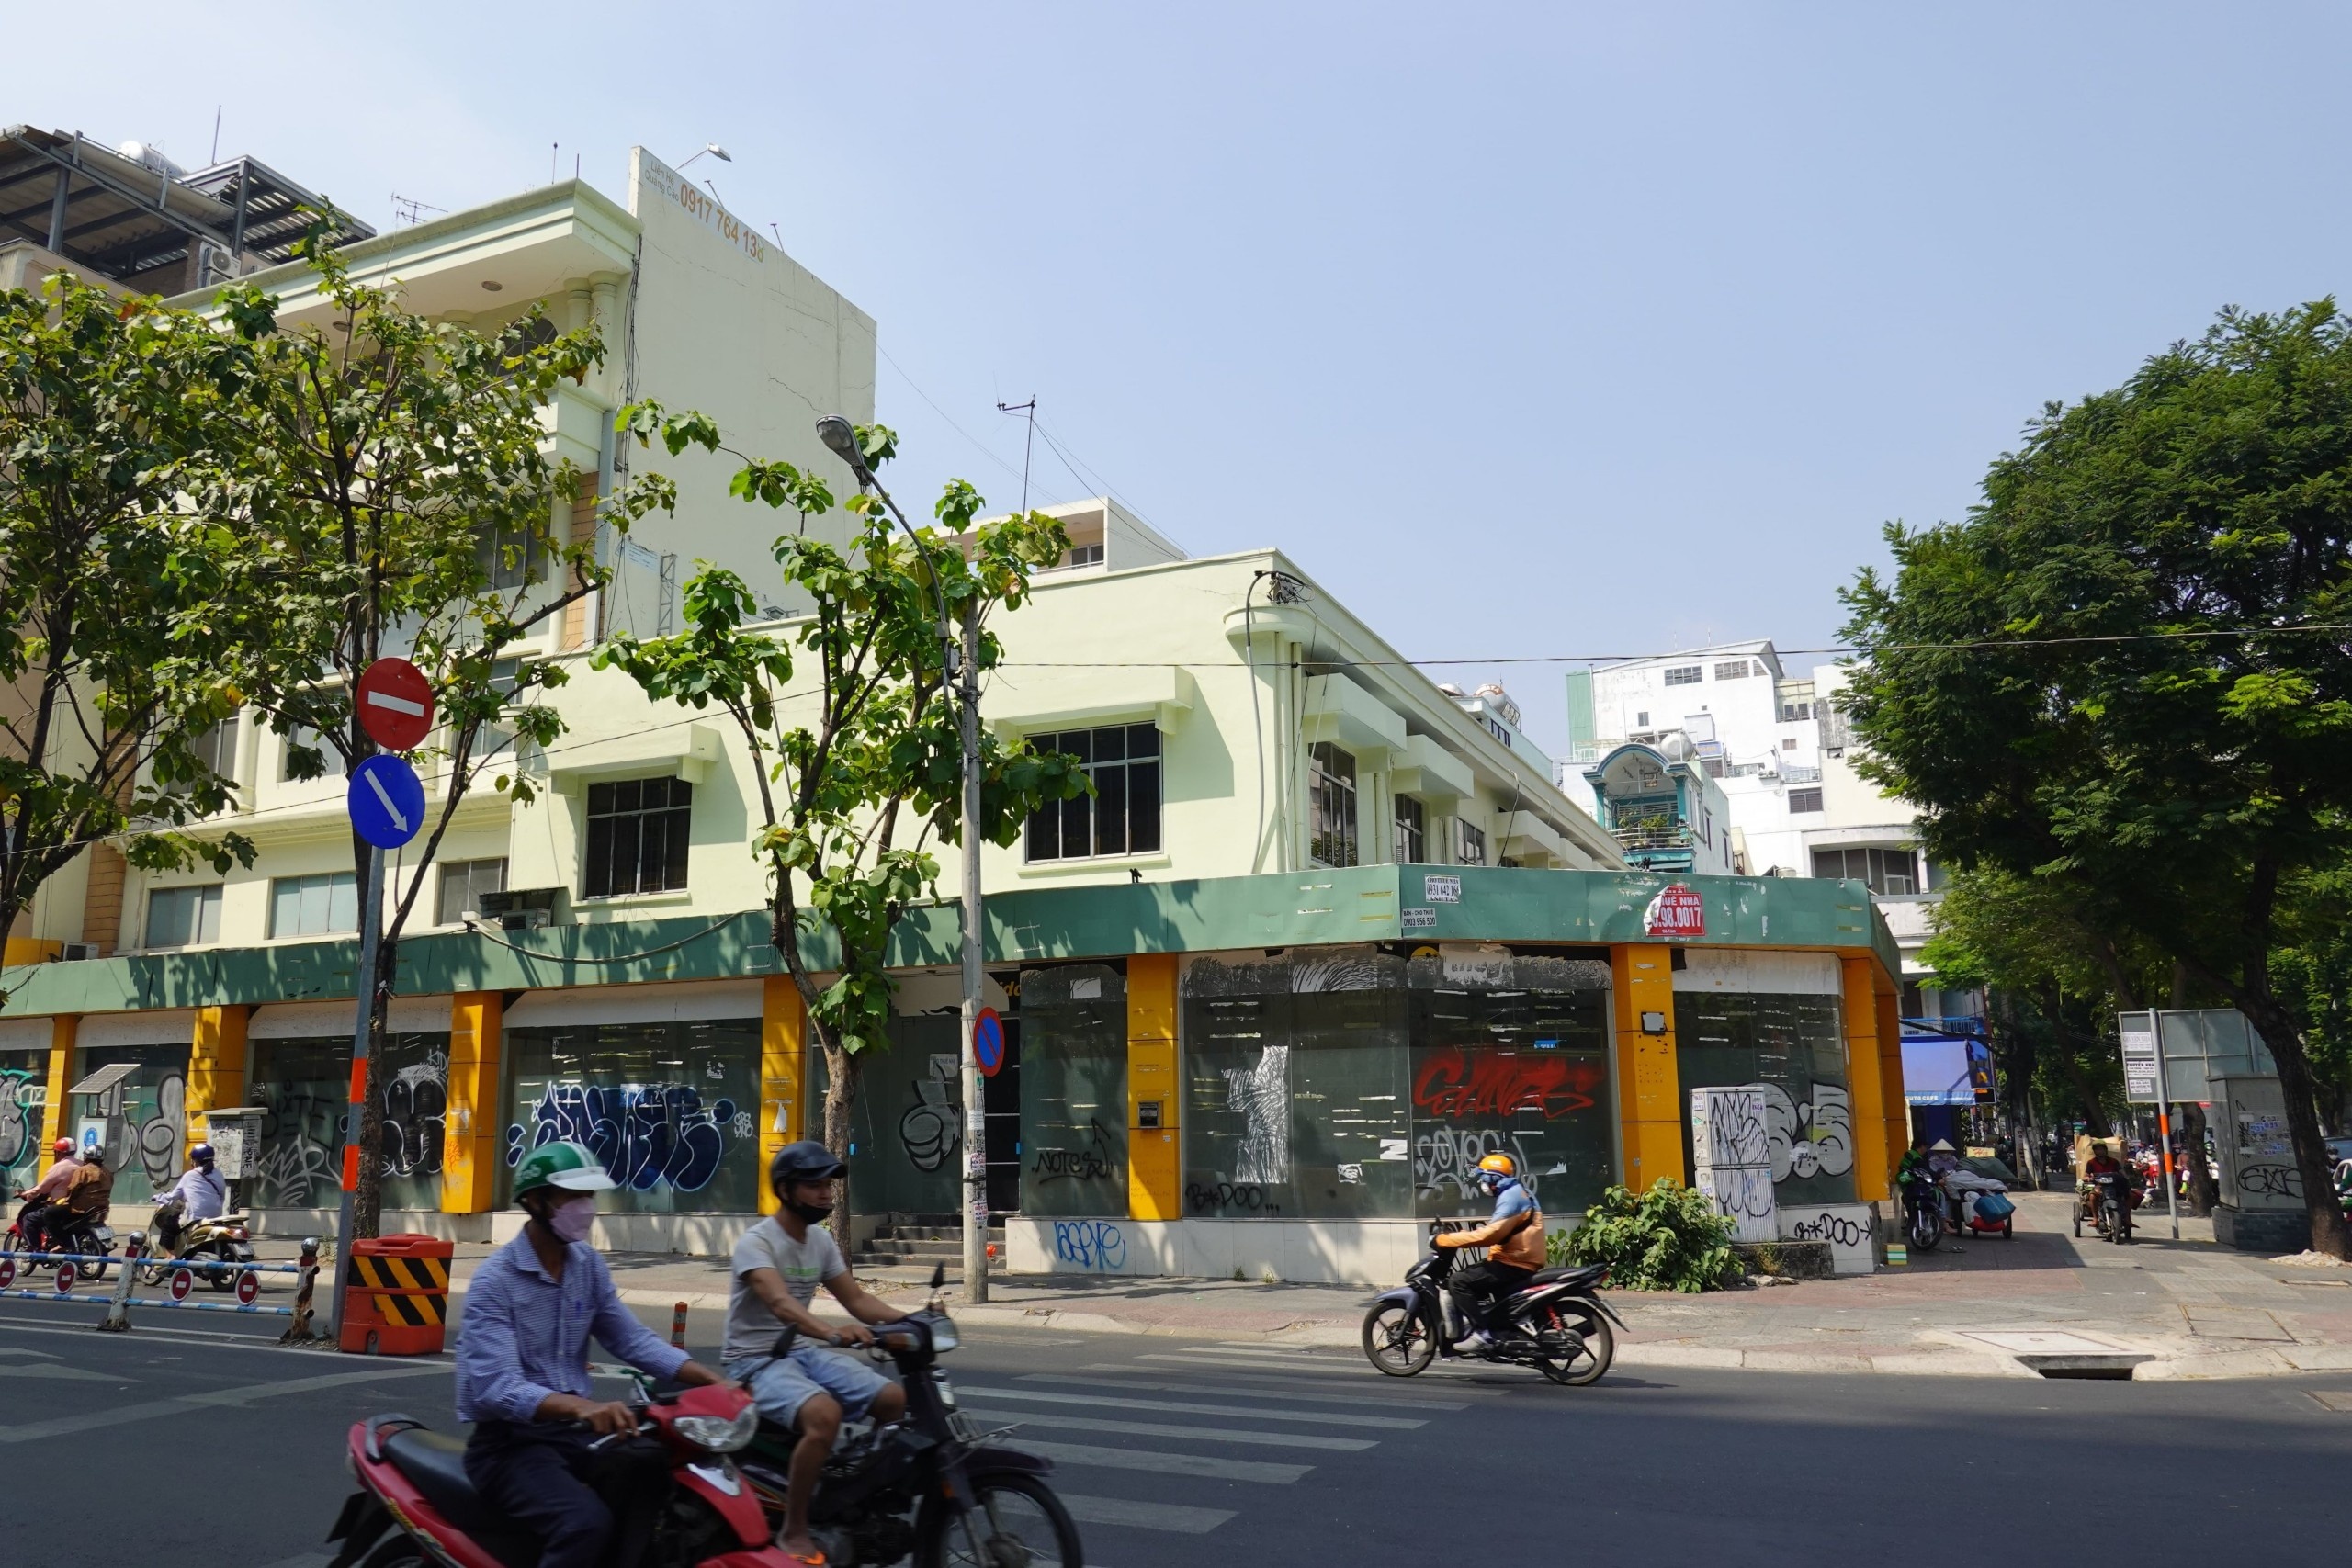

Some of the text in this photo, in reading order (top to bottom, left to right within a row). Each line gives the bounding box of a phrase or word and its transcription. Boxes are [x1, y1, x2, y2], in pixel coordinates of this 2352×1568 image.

[681, 183, 713, 223] 0917
[717, 209, 739, 245] 764
[1440, 885, 1450, 896] 642
[1679, 895, 1700, 906] NHÀ
[1403, 918, 1416, 927] 0903
[1427, 917, 1436, 926] 500
